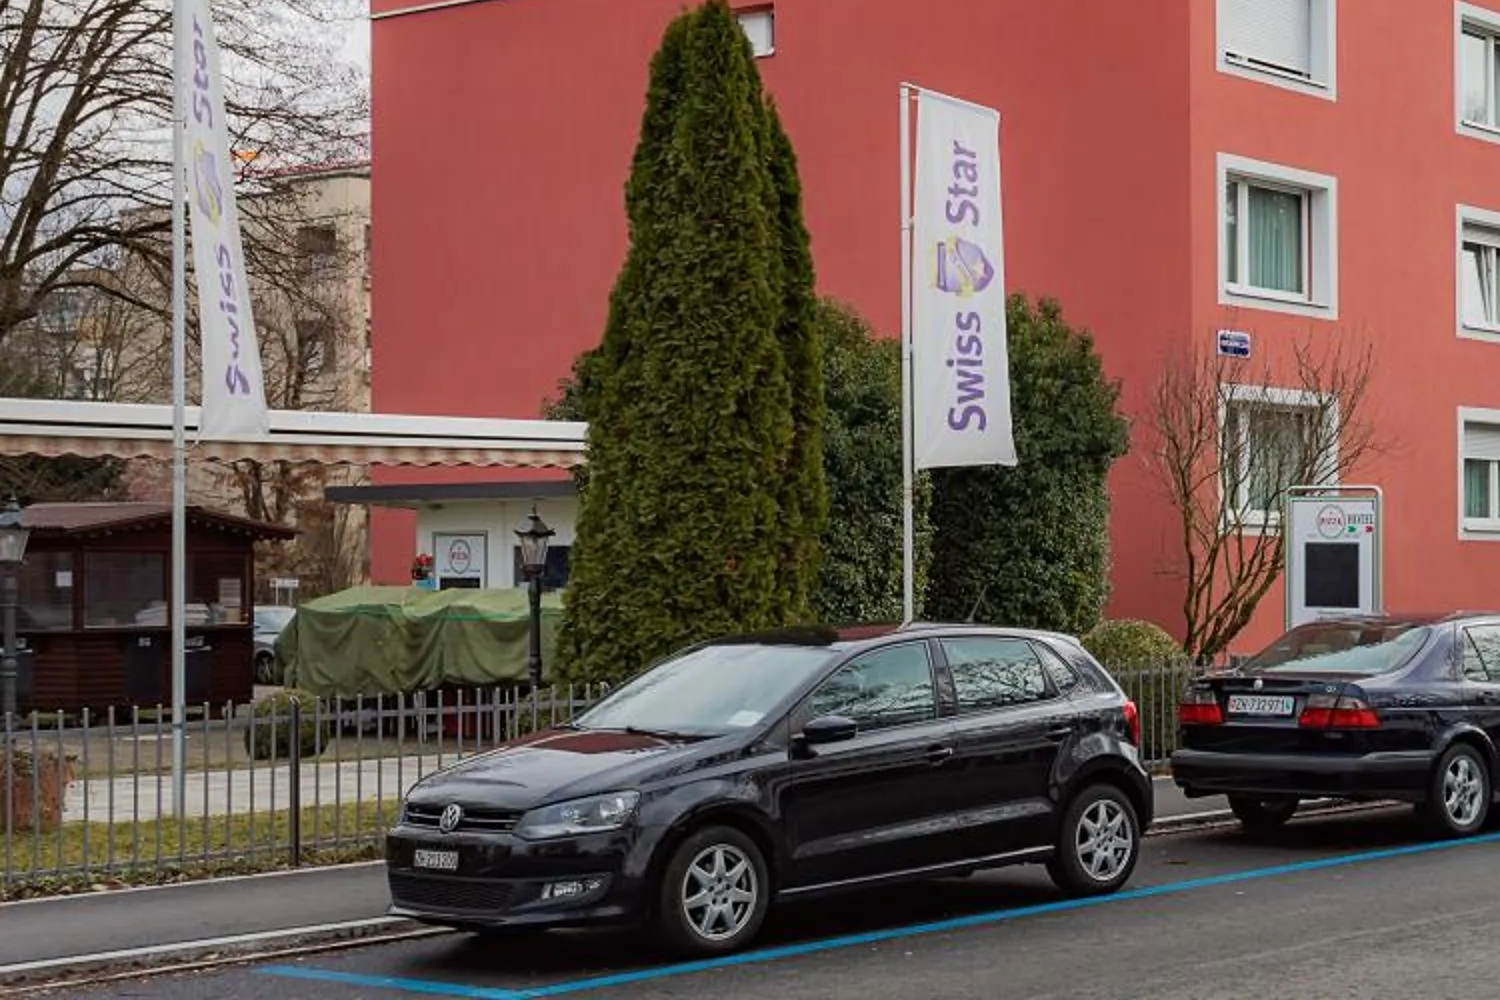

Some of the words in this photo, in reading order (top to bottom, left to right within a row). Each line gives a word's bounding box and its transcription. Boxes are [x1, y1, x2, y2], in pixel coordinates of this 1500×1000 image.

[192, 13, 213, 130] Star
[945, 139, 980, 227] Star
[214, 243, 251, 396] Swiss
[947, 311, 988, 432] Swiss
